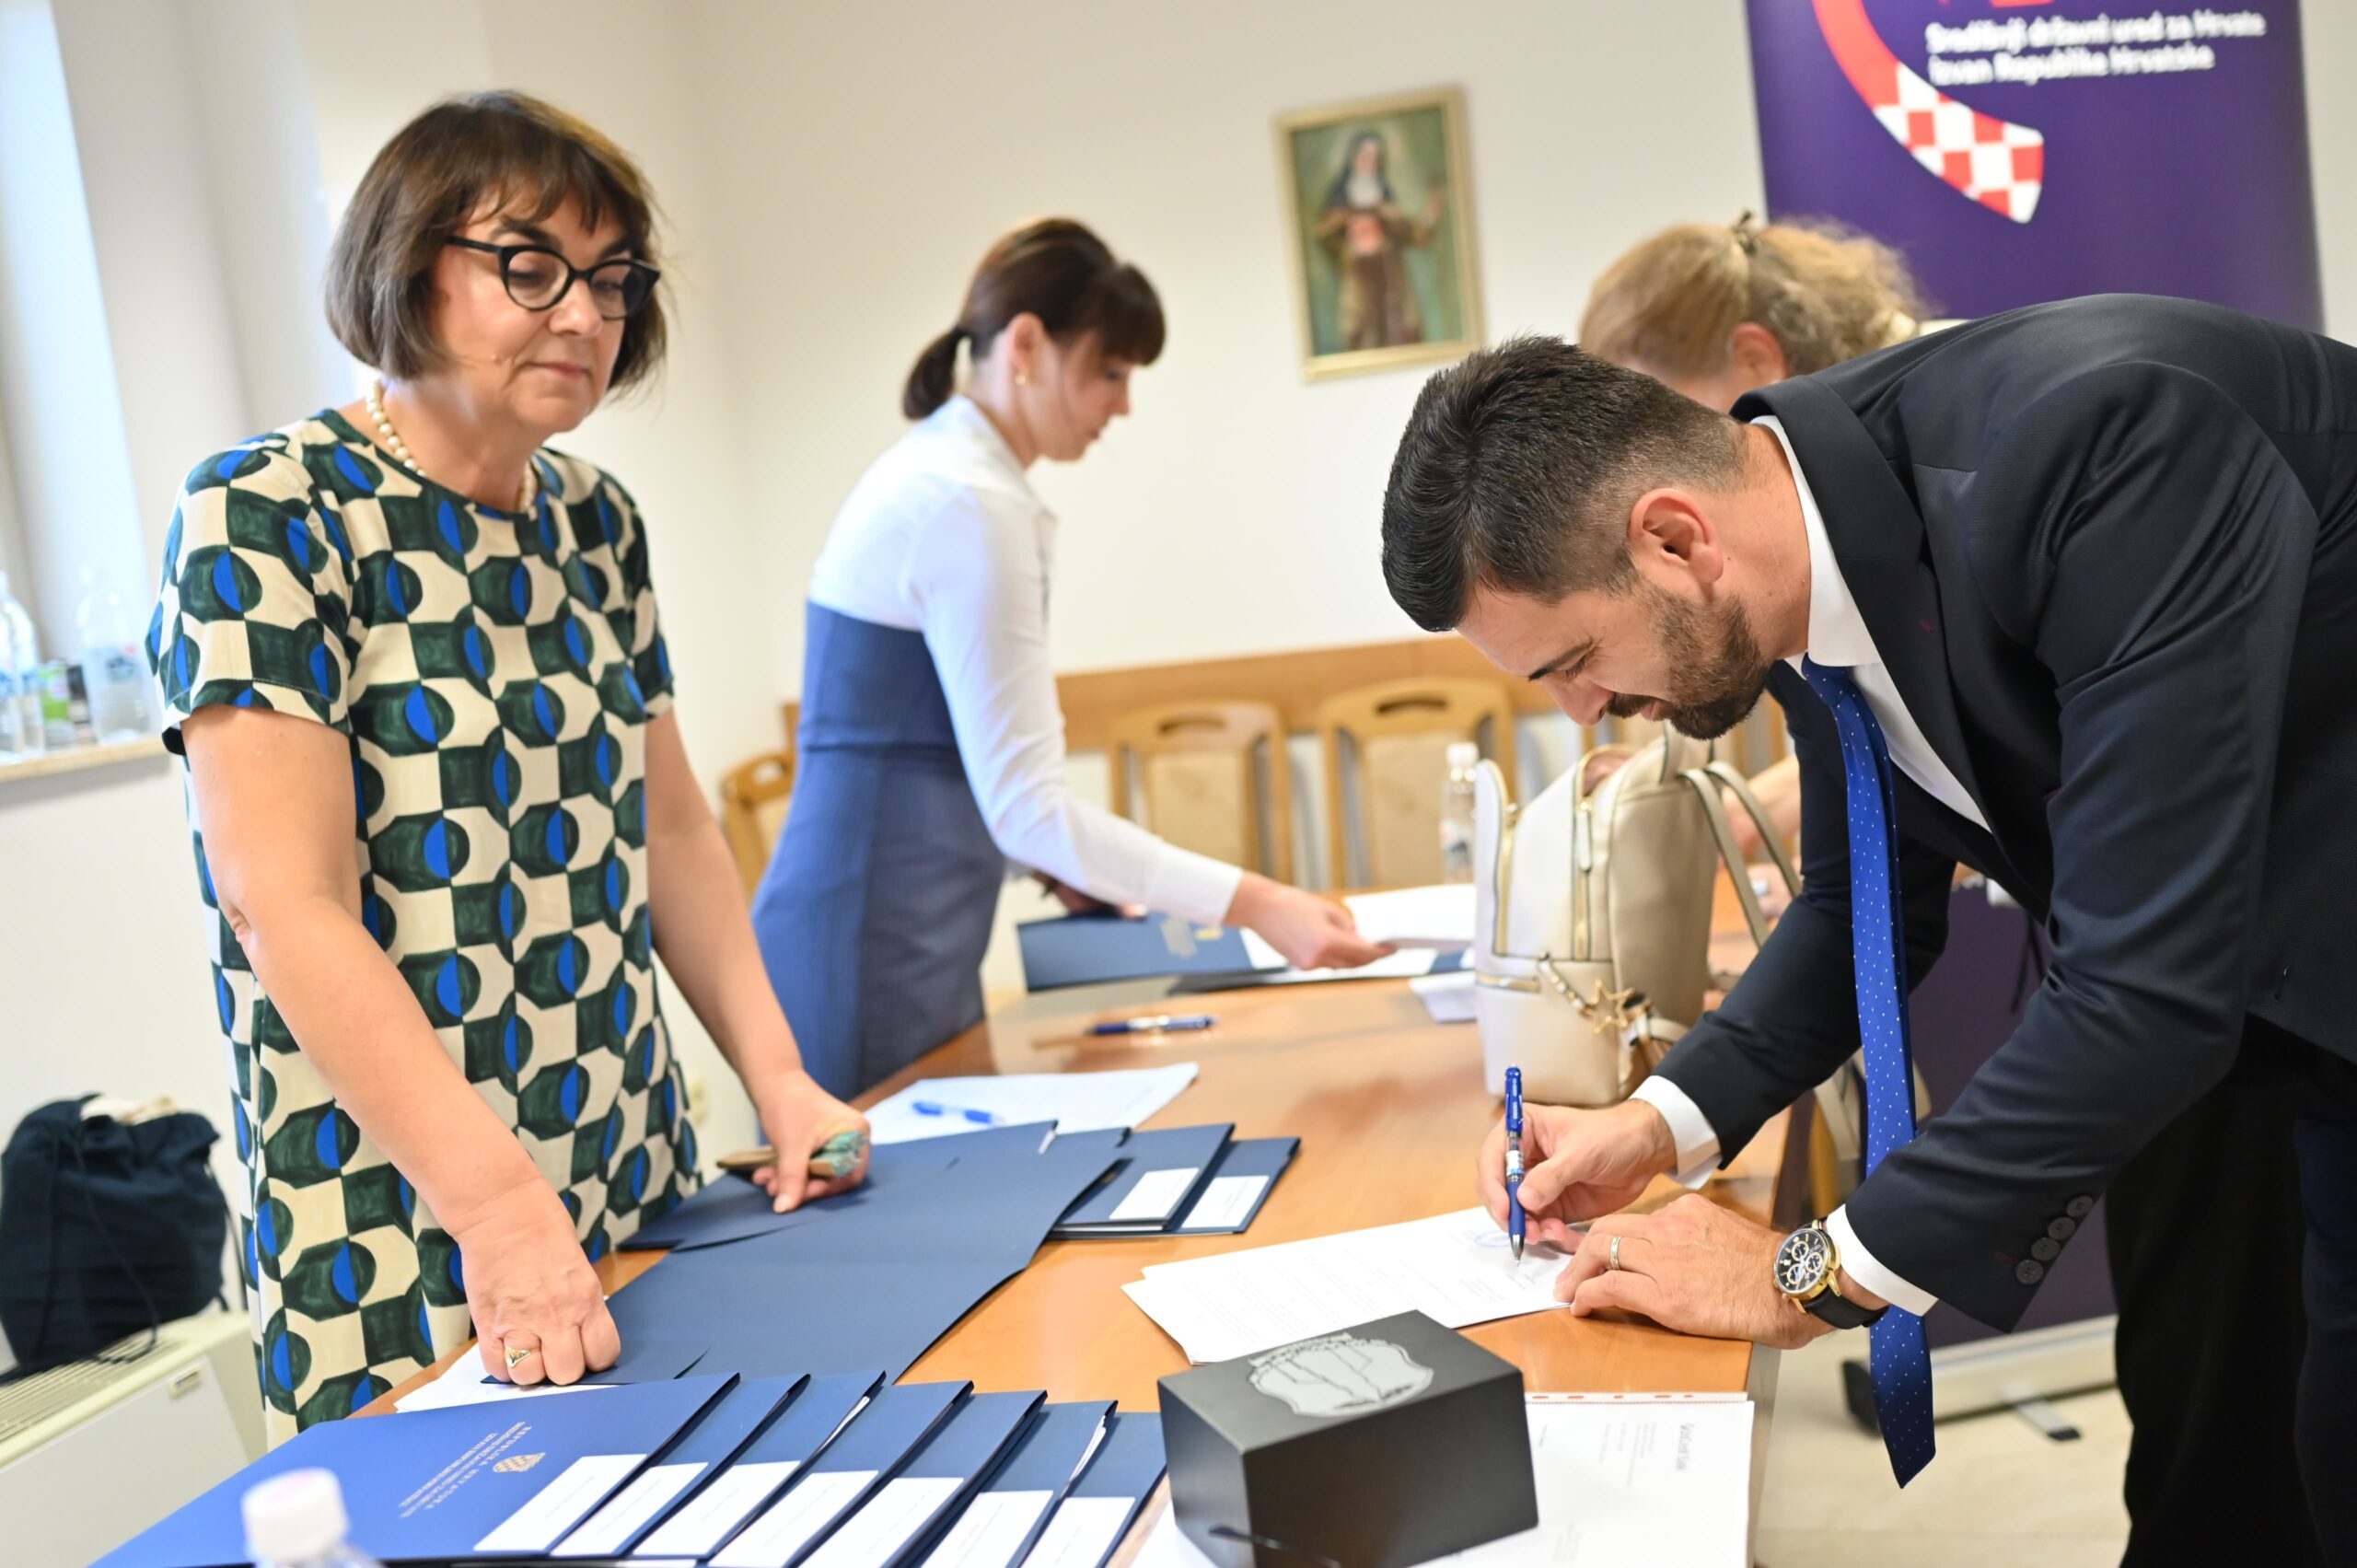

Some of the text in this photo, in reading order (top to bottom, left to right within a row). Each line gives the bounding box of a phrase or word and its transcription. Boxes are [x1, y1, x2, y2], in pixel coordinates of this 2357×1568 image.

[2110, 10, 2165, 44] ured
[2165, 15, 2192, 41] za
[2191, 8, 2267, 39] Hrvate
[1992, 46, 2110, 87] Republike
[2107, 40, 2215, 75] Hrvatske
